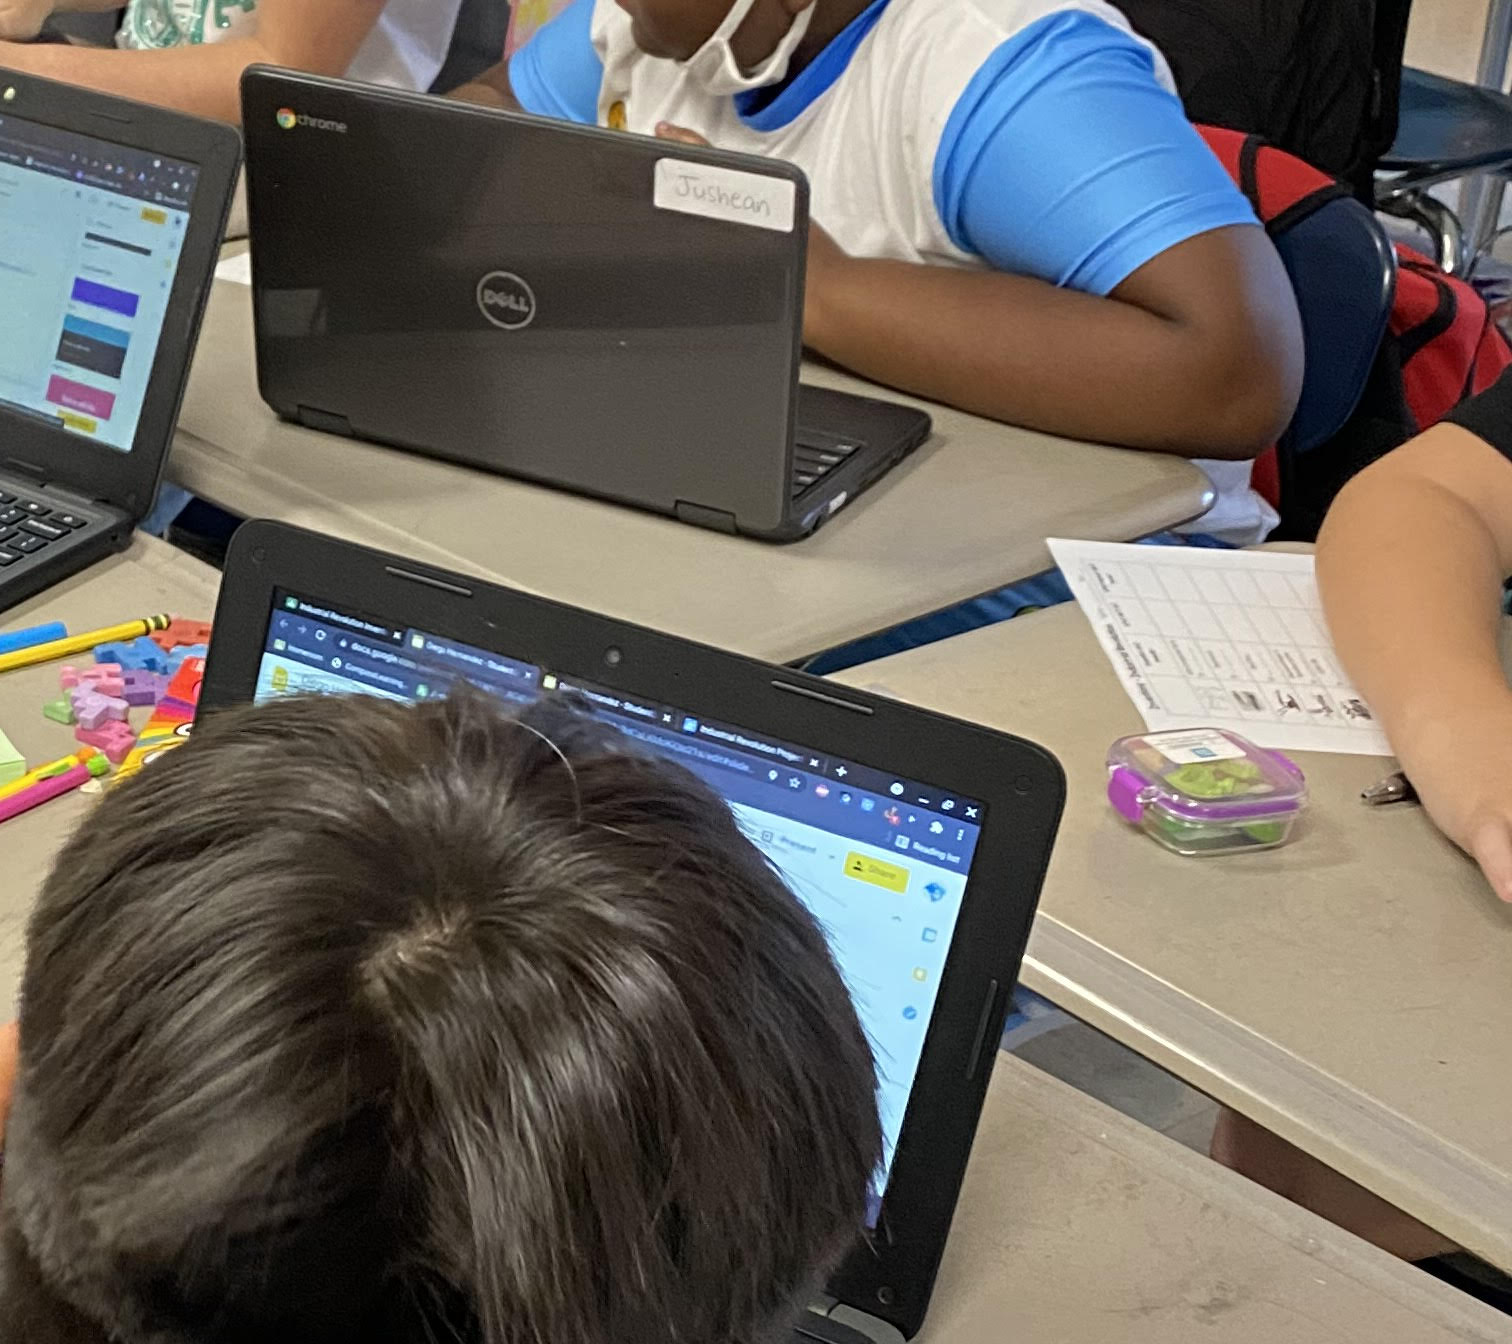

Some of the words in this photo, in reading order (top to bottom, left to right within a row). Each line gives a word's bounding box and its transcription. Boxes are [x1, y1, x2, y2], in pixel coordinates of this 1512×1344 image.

[296, 115, 348, 134] chrome
[673, 172, 771, 217] Jushean
[482, 288, 530, 314] DELL
[912, 840, 946, 861] Reading
[945, 851, 962, 865] list
